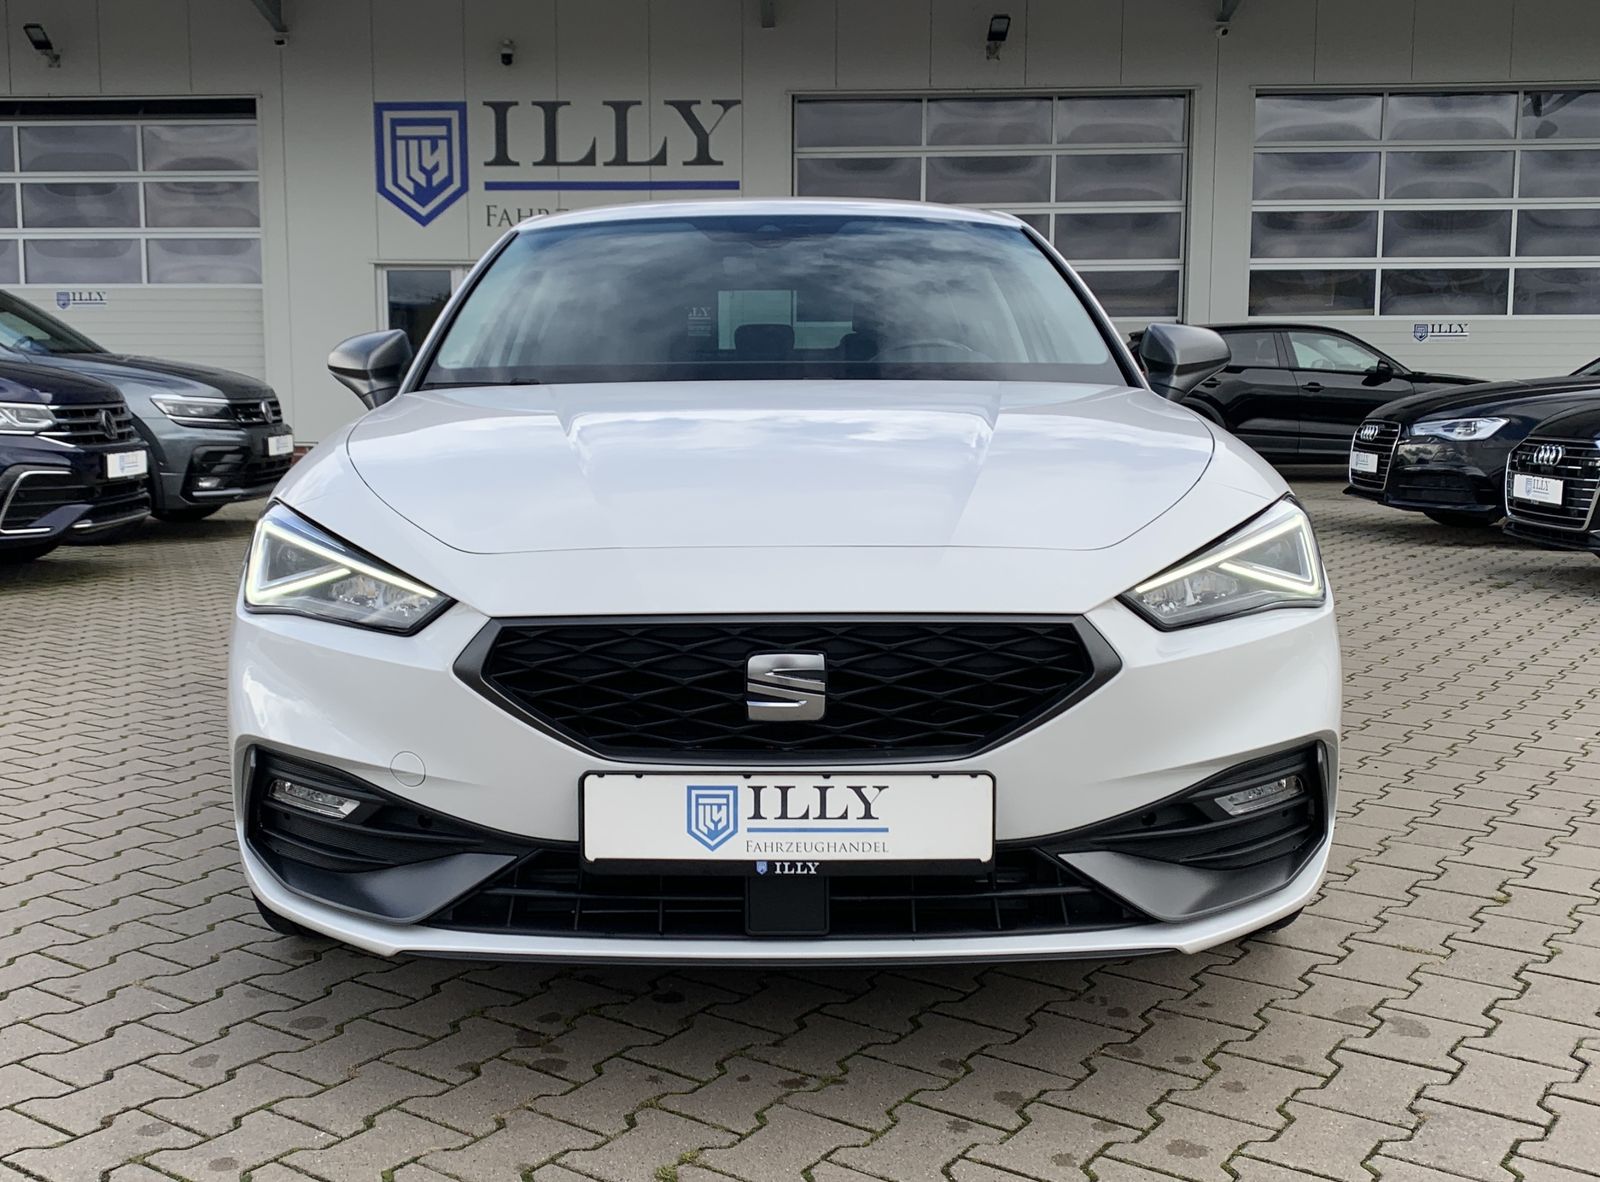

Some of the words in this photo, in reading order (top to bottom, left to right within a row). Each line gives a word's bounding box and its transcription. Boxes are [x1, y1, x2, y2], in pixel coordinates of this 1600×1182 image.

[482, 100, 742, 167] ILLY
[486, 204, 569, 228] FAH
[72, 291, 107, 301] ILLY
[1430, 323, 1468, 333] ILLY
[746, 785, 890, 820] ILLY
[745, 839, 890, 854] FAHRZEUGHANDEL
[774, 861, 820, 875] ILLY
